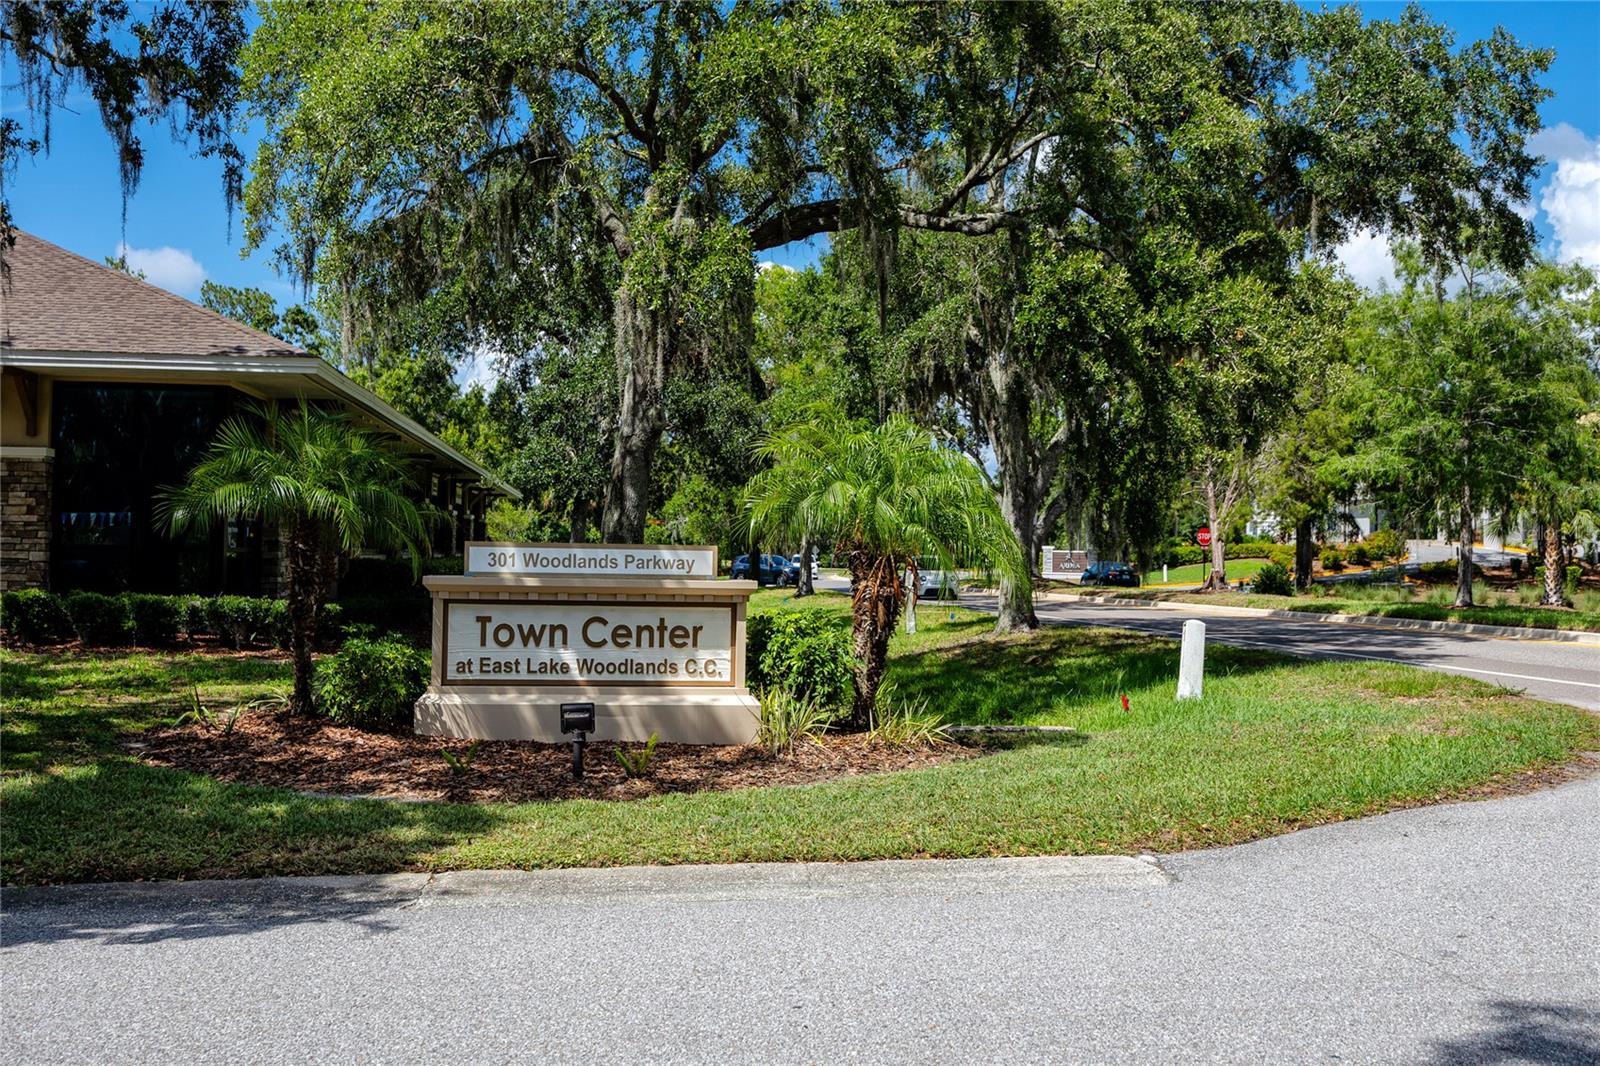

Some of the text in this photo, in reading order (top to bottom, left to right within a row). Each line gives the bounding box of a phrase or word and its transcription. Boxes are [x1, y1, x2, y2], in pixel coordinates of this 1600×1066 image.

[1197, 532, 1211, 540] STOP
[487, 552, 695, 574] 301 Woodlands Parkway
[475, 615, 703, 649] Town Center
[455, 657, 722, 676] at East Lake Woodlands C.C.
